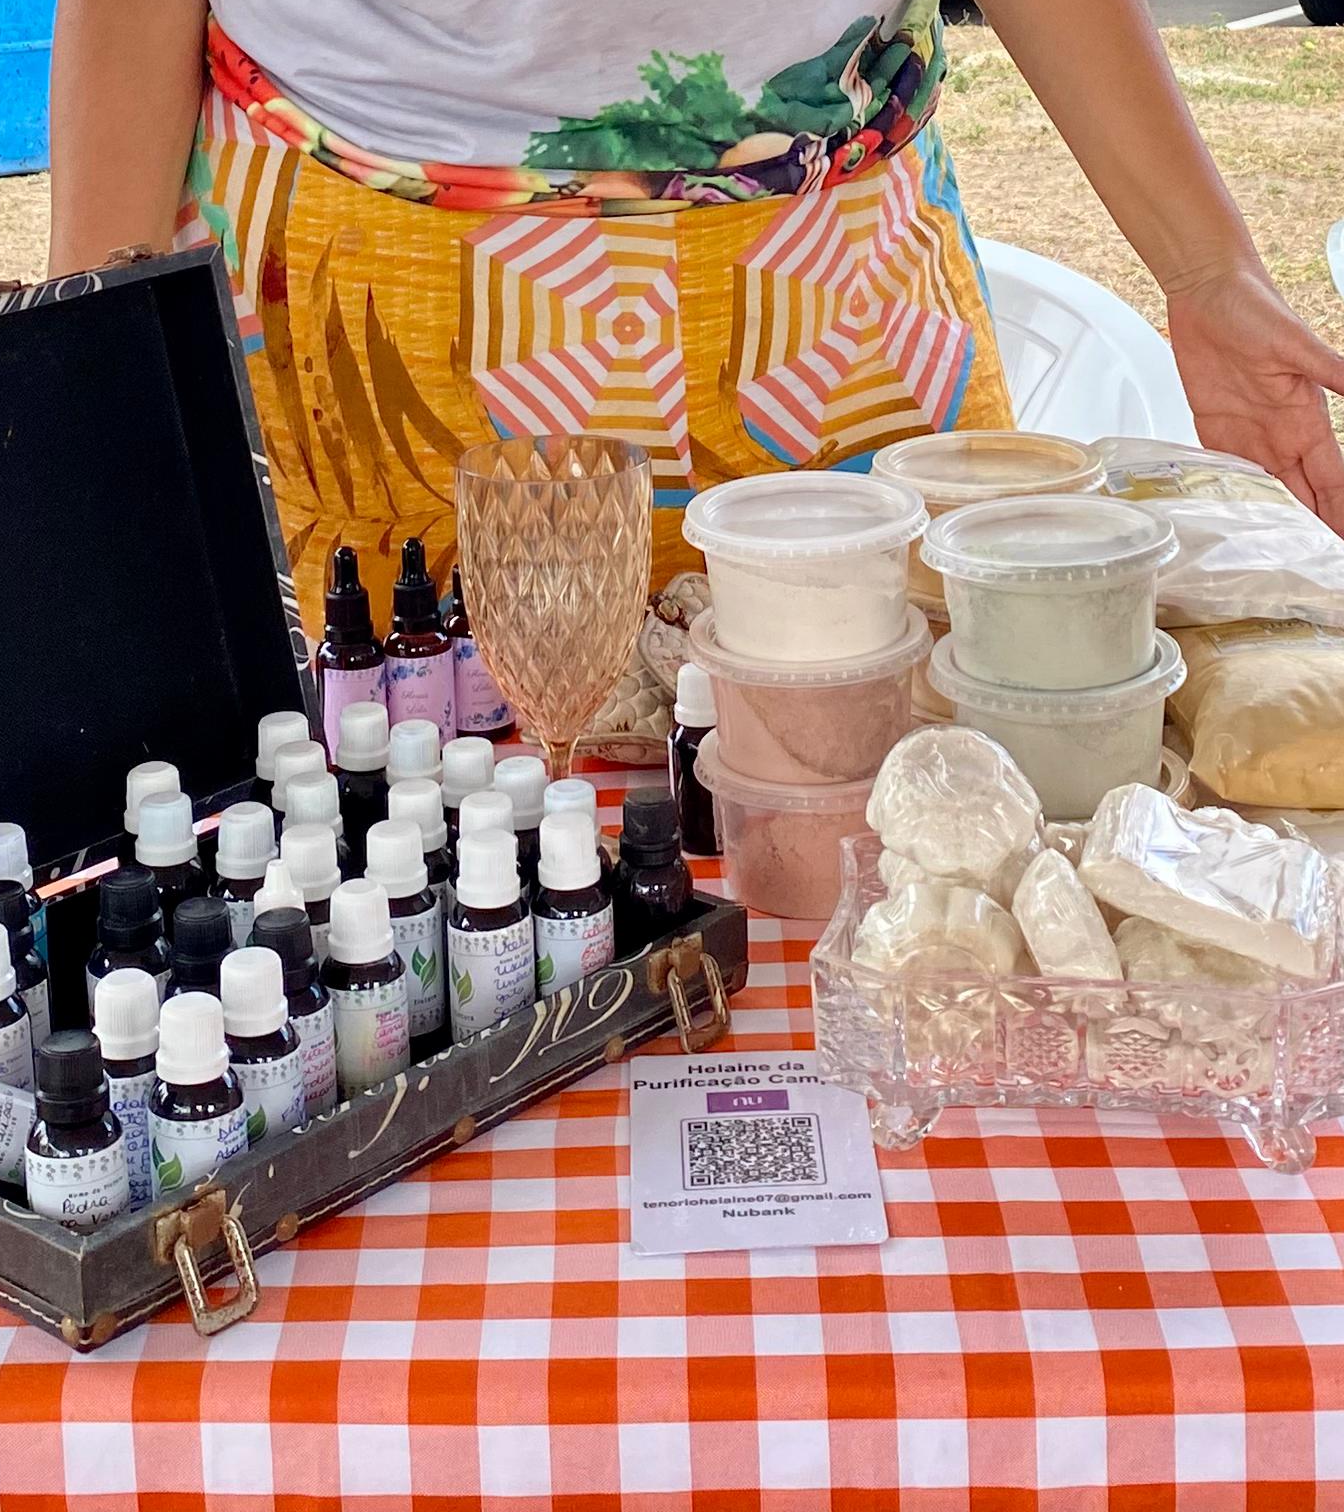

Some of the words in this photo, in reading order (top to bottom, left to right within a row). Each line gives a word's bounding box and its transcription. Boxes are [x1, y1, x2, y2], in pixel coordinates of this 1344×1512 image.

[688, 1063, 770, 1075] Helaine
[778, 1061, 805, 1072] da
[633, 1075, 761, 1090] Purificação
[722, 1207, 796, 1219] Nubank
